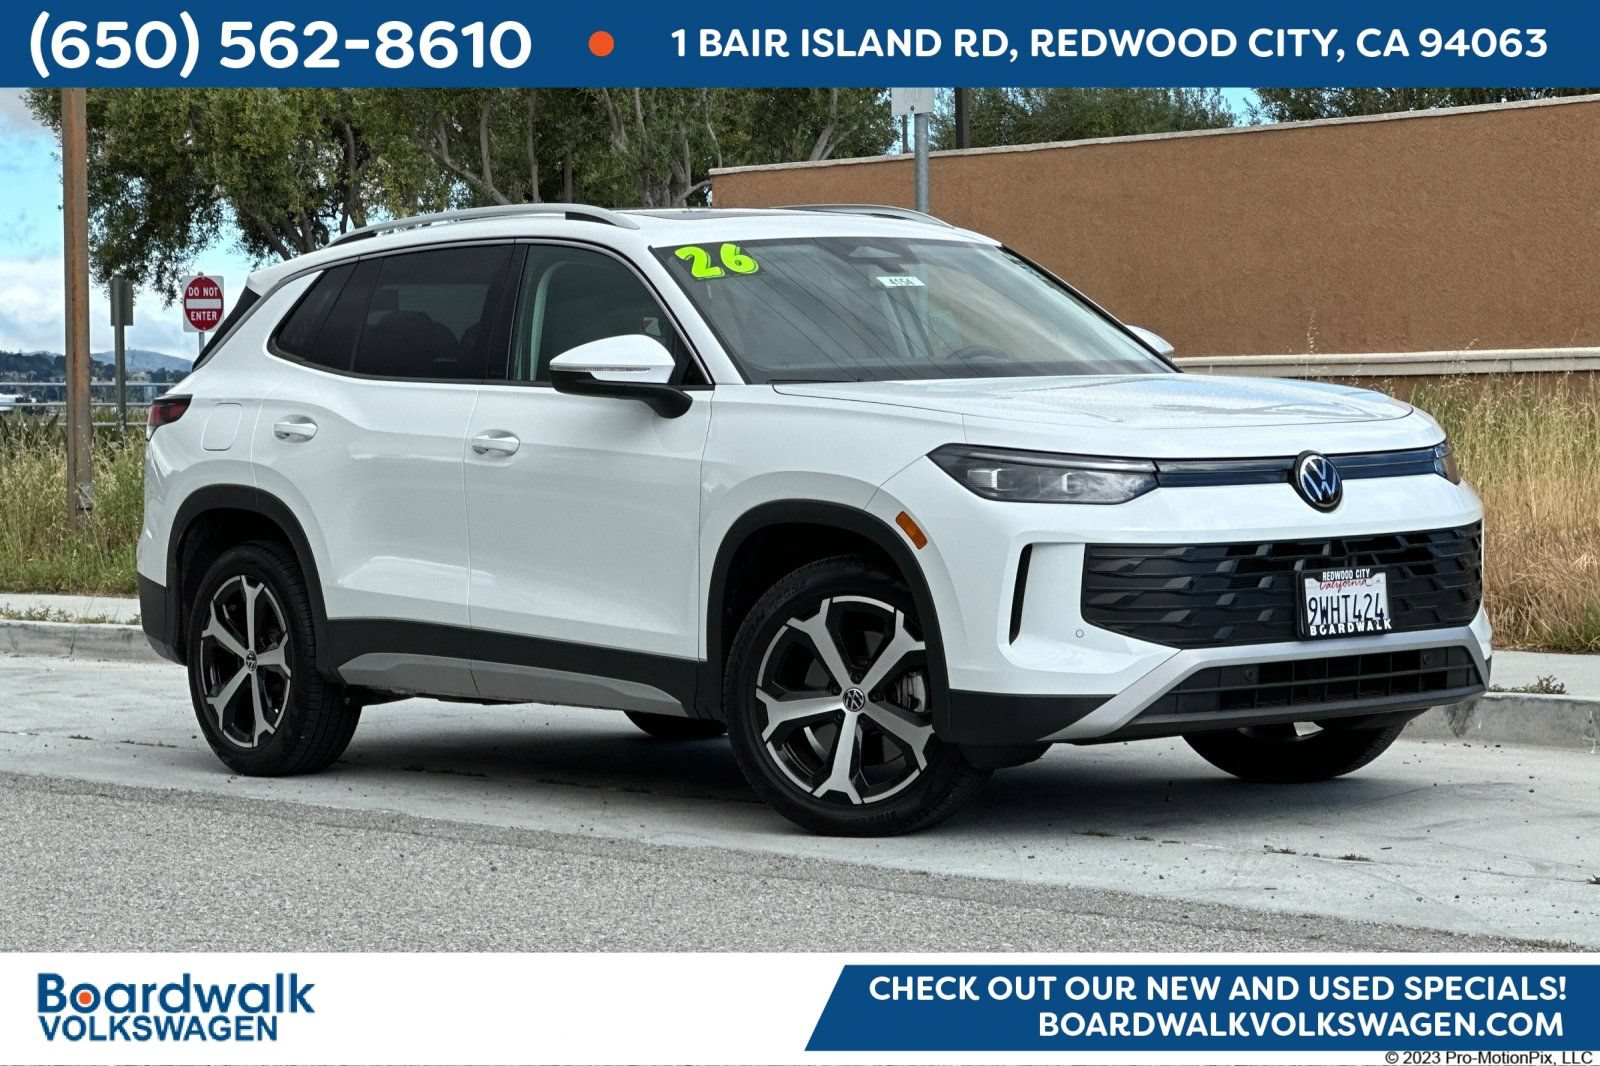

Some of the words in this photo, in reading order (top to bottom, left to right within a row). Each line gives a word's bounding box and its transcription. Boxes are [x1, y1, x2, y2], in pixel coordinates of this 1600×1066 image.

[675, 243, 759, 280] 26
[188, 287, 200, 297] DO
[202, 287, 219, 297] NOT
[190, 311, 218, 321] ENTER
[1322, 570, 1353, 581] REDWOOD
[1355, 568, 1370, 578] CITY
[1308, 592, 1385, 626] 9WHT424
[1309, 619, 1392, 636] BOARDWALK
